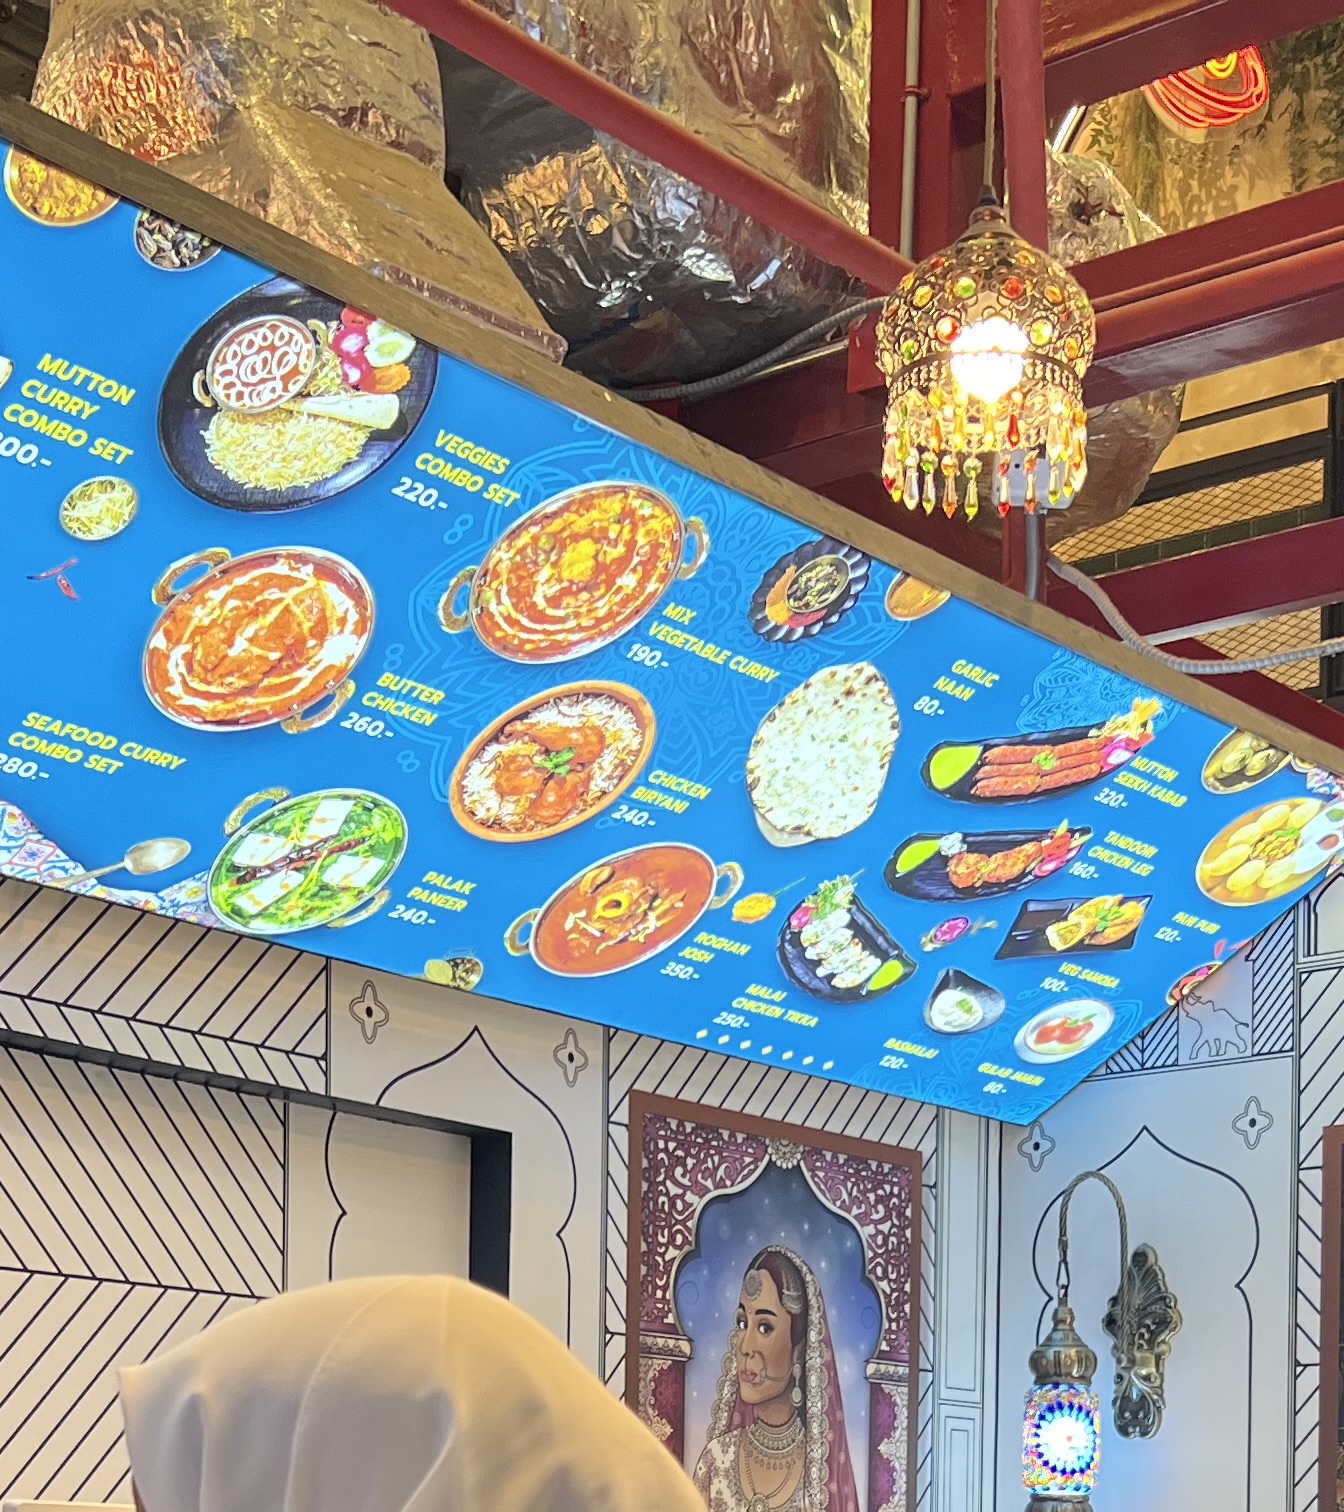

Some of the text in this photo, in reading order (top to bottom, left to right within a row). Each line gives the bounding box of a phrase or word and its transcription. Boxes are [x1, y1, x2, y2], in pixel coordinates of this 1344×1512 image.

[38, 353, 137, 406] MUTTON
[21, 379, 100, 420] CURRY
[4, 404, 134, 465] COMBO SET
[434, 429, 511, 475] VEGGIES
[392, 477, 448, 511] 220.-
[415, 453, 521, 509] COMBO SET
[663, 602, 698, 627] MIX
[627, 643, 669, 671] 190.-
[649, 621, 781, 684] VEGETABLE CURRY
[376, 671, 446, 706] BUTTER
[933, 675, 976, 702] NAAN
[950, 659, 1000, 689] GARLIC
[362, 690, 439, 727] CHICKEN
[340, 711, 395, 739] 260.-
[8, 731, 124, 776] COMBO SET
[21, 711, 187, 771] SEAFOOD CURRY
[649, 769, 713, 801] CHICKEN
[631, 785, 691, 816] BIRYANI
[611, 804, 657, 829] 240.-
[422, 870, 477, 896] PALAK
[406, 886, 468, 913] PANEER
[388, 904, 436, 926] 240.-
[677, 946, 715, 964] JOSH
[693, 931, 752, 957] ROGHAN
[745, 983, 788, 1003] MALAI
[731, 997, 786, 1020] CHICKEN
